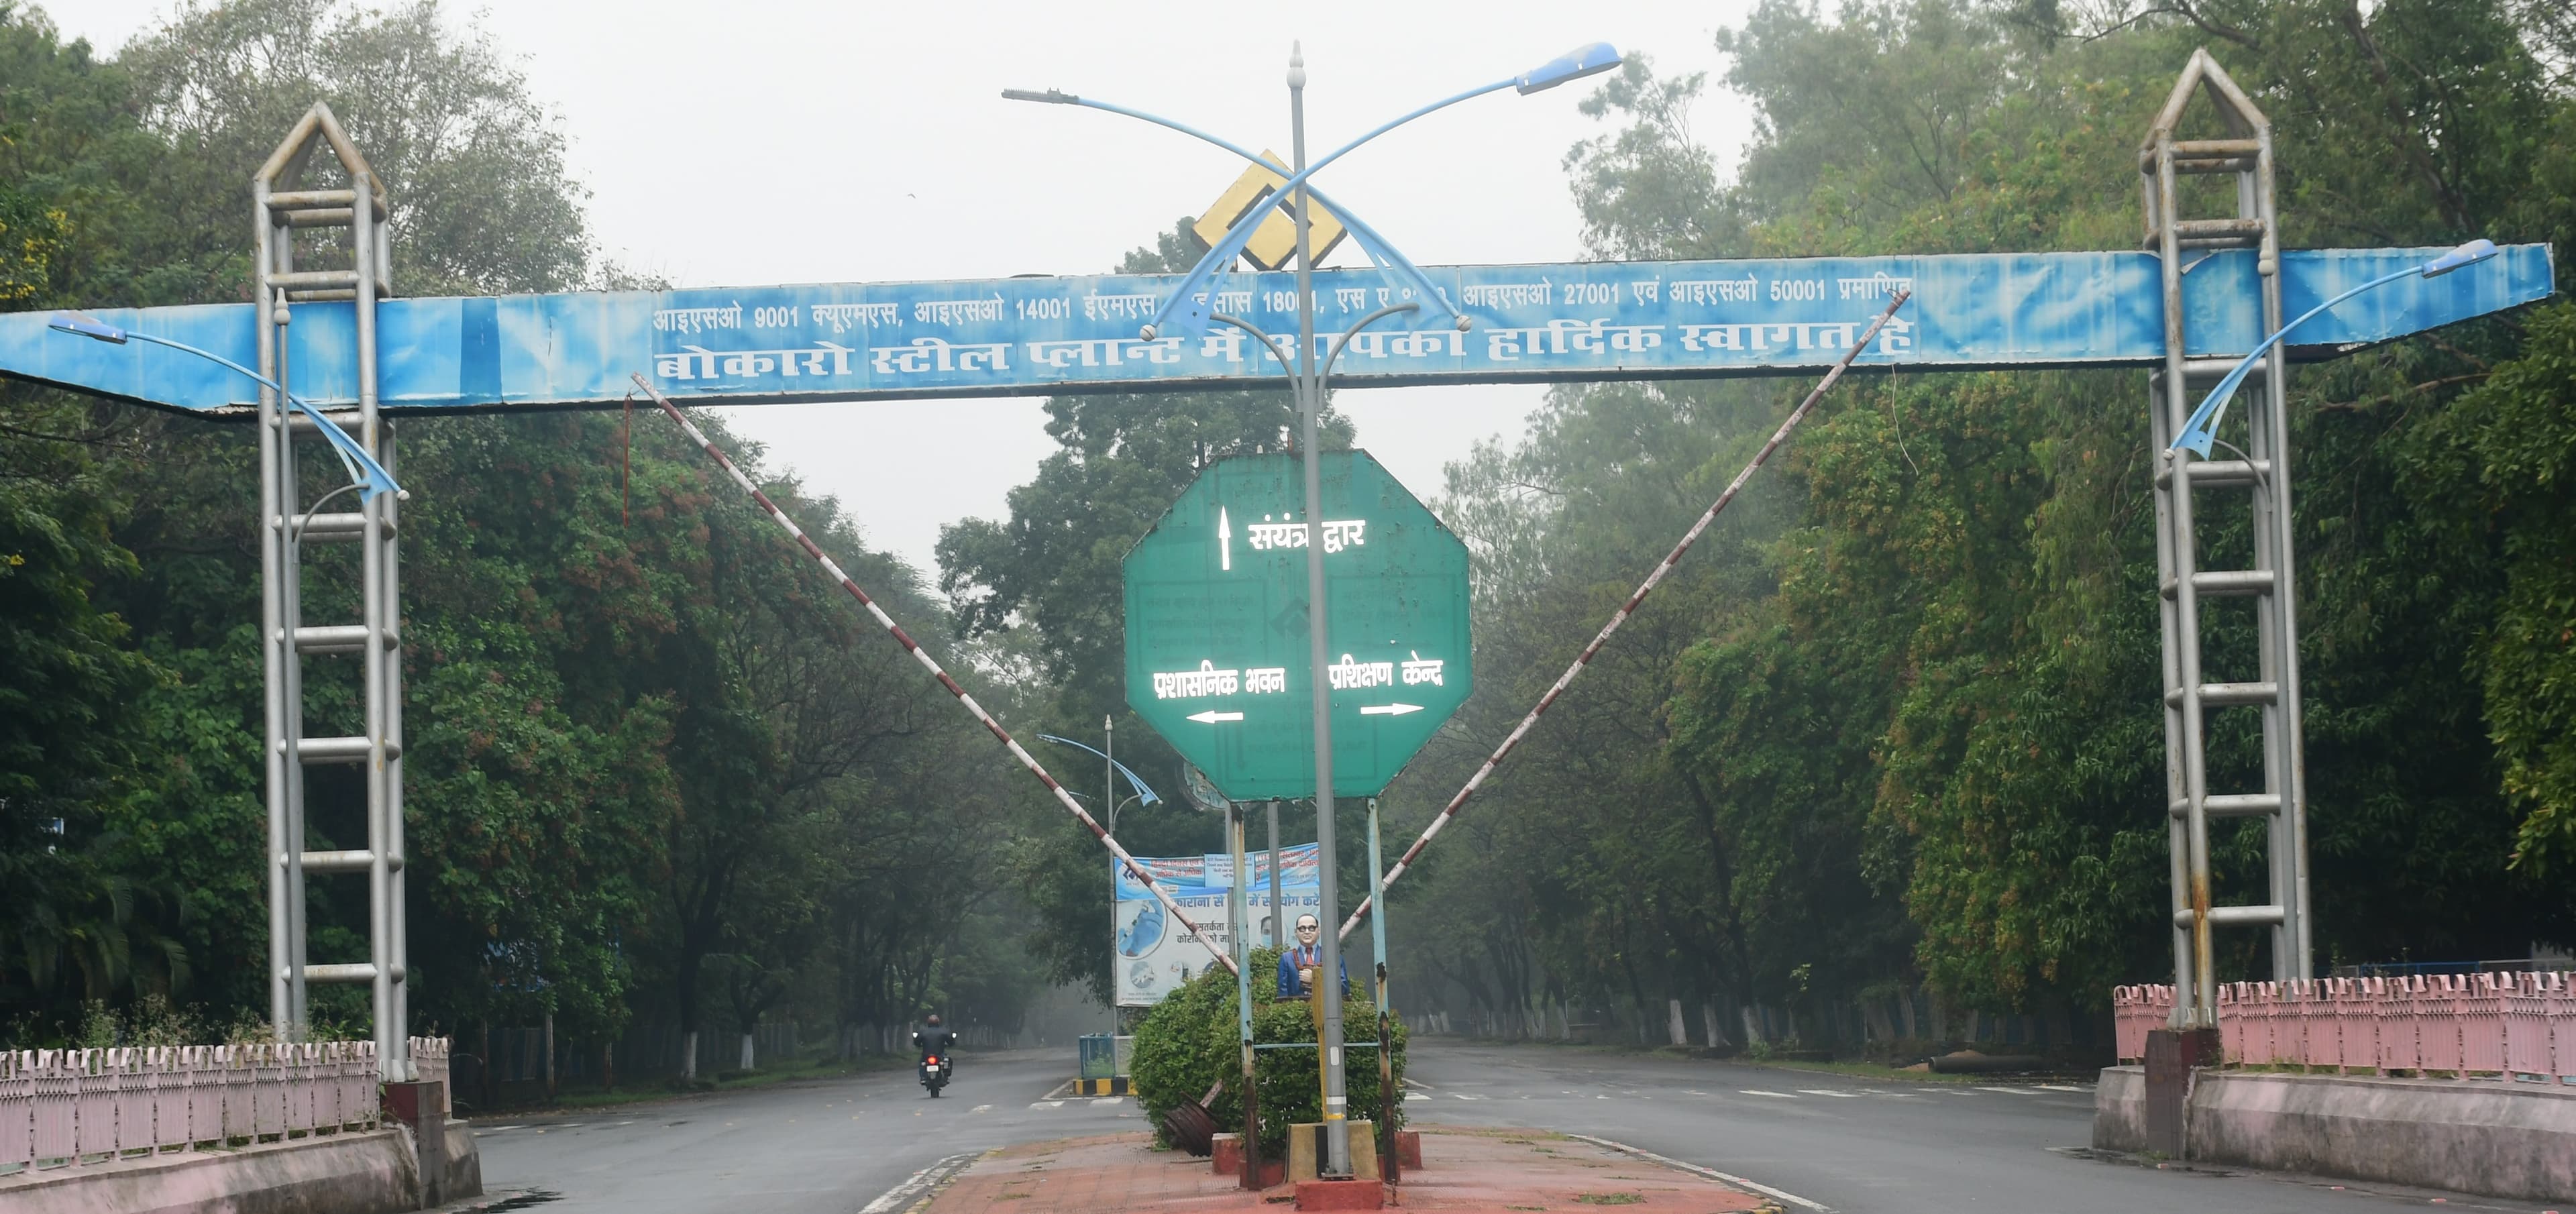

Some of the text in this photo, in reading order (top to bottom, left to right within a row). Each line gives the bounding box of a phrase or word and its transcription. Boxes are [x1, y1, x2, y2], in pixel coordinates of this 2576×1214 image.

[653, 300, 743, 334] आइएसओ
[755, 306, 798, 329] 9001
[811, 302, 904, 333] क्यूएमएस,
[914, 291, 1005, 327] आइएसओ
[1016, 298, 1071, 321] 14001
[1263, 290, 1325, 314] 1801,
[1335, 288, 1366, 314] एस
[1376, 288, 1390, 309] ए
[1463, 276, 1552, 311] आइएसओ
[1564, 282, 1619, 305] 27001
[1631, 275, 1660, 307] एवं
[1669, 272, 1758, 307] आइएसओ
[1770, 279, 1825, 301] 50001
[654, 341, 856, 380] बोकारो
[869, 337, 1013, 374] स्टील
[1026, 335, 1185, 368] प्लान्ट
[1201, 327, 1246, 362] में
[1265, 329, 1470, 362] आपका
[1484, 317, 1665, 361] हार्दिक
[1678, 322, 1861, 351] स्वागत
[1248, 512, 1366, 553] संयंत्र द्वार
[1153, 659, 1285, 700] प्रशासनिक भवन
[1328, 649, 1444, 690] प्रशिक्षण केन्द्र
